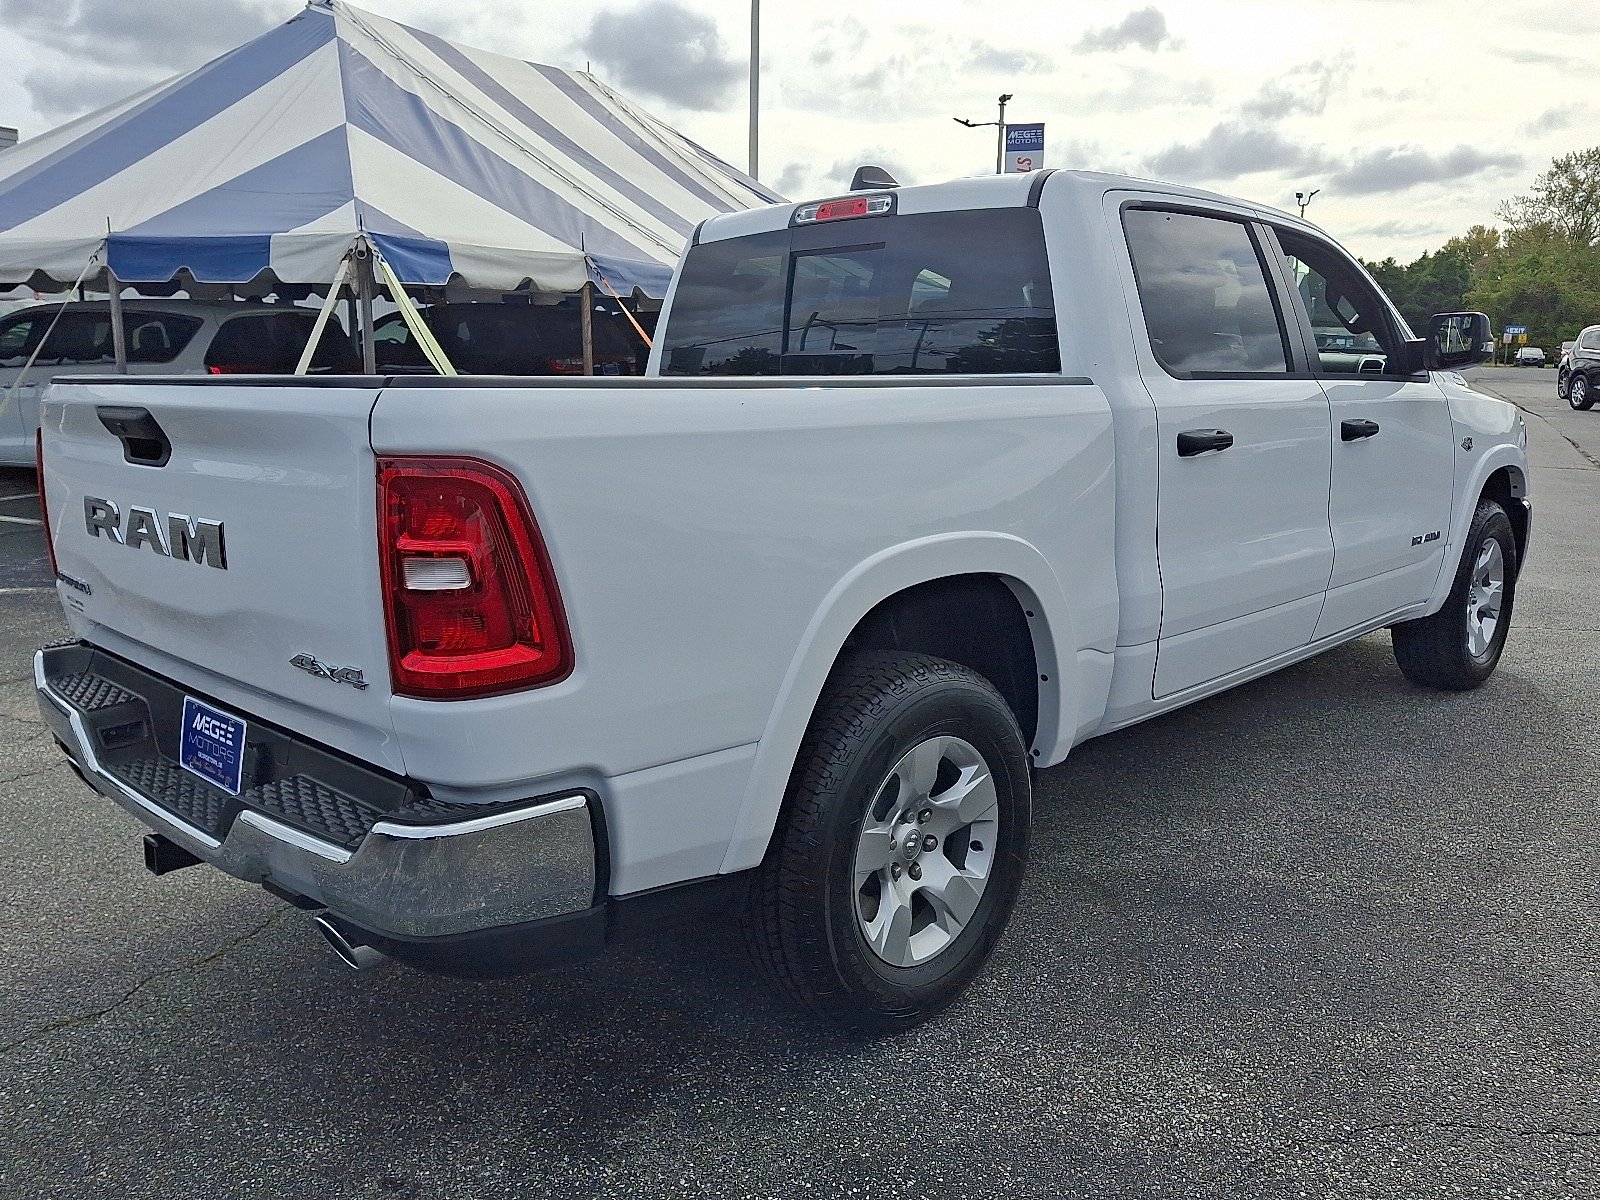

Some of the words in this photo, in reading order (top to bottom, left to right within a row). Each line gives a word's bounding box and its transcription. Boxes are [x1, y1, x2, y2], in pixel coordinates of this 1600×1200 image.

[1008, 130, 1043, 139] MEGEE
[83, 495, 228, 570] RAM
[192, 712, 235, 747] MEGEE
[188, 731, 235, 765] MOTORS
